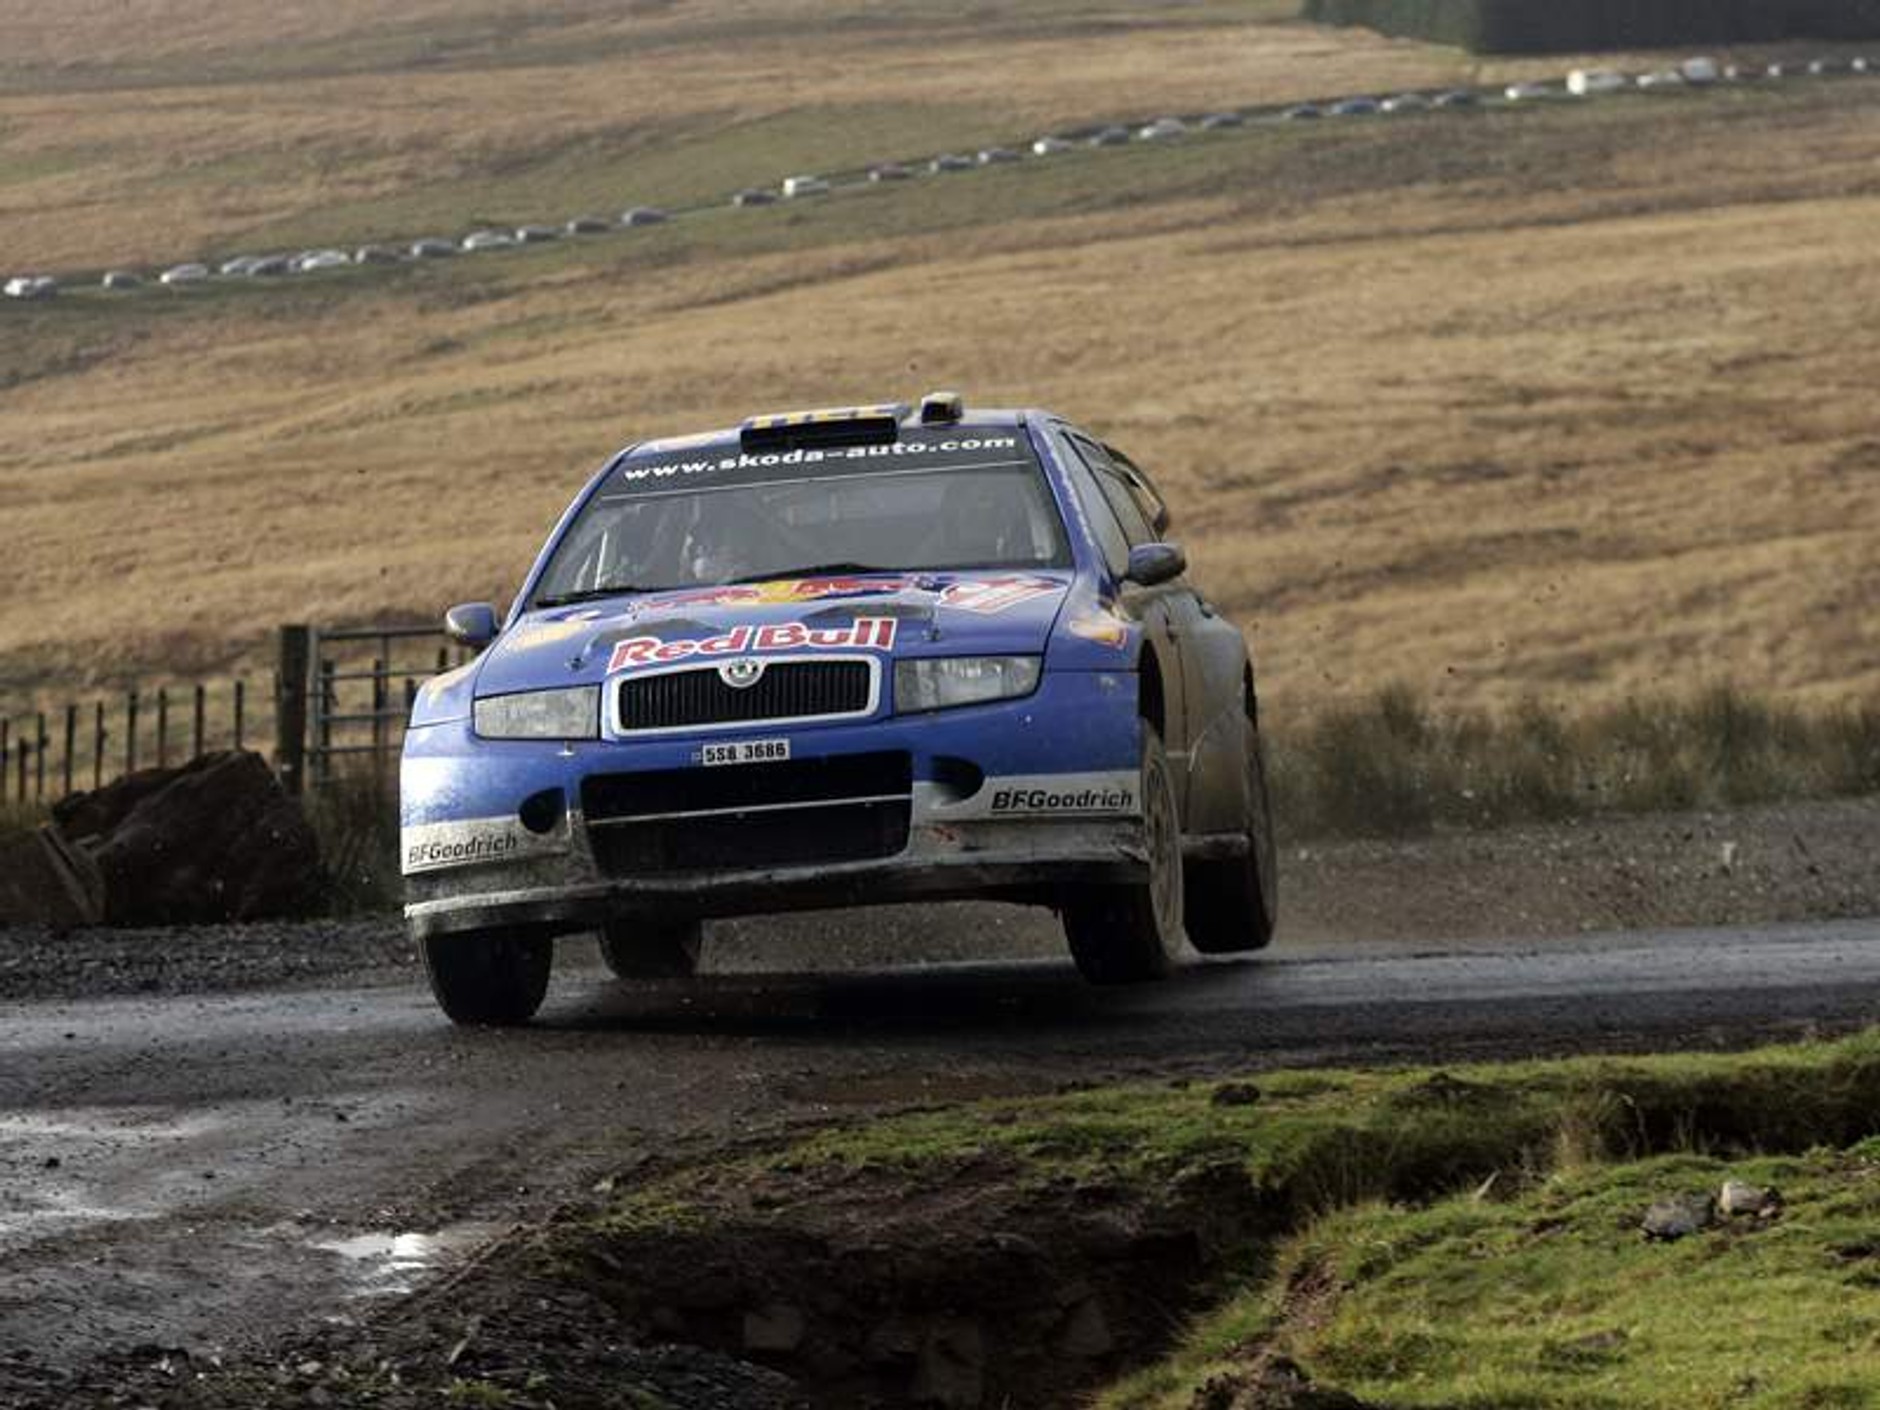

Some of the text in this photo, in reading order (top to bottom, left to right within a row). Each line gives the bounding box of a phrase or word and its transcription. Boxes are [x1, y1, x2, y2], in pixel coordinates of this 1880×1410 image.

[624, 436, 1016, 480] www.skoda-auto.com
[608, 618, 897, 672] Red Bull
[991, 787, 1133, 811] BFGoodrich
[409, 833, 517, 863] BFGoodrich
